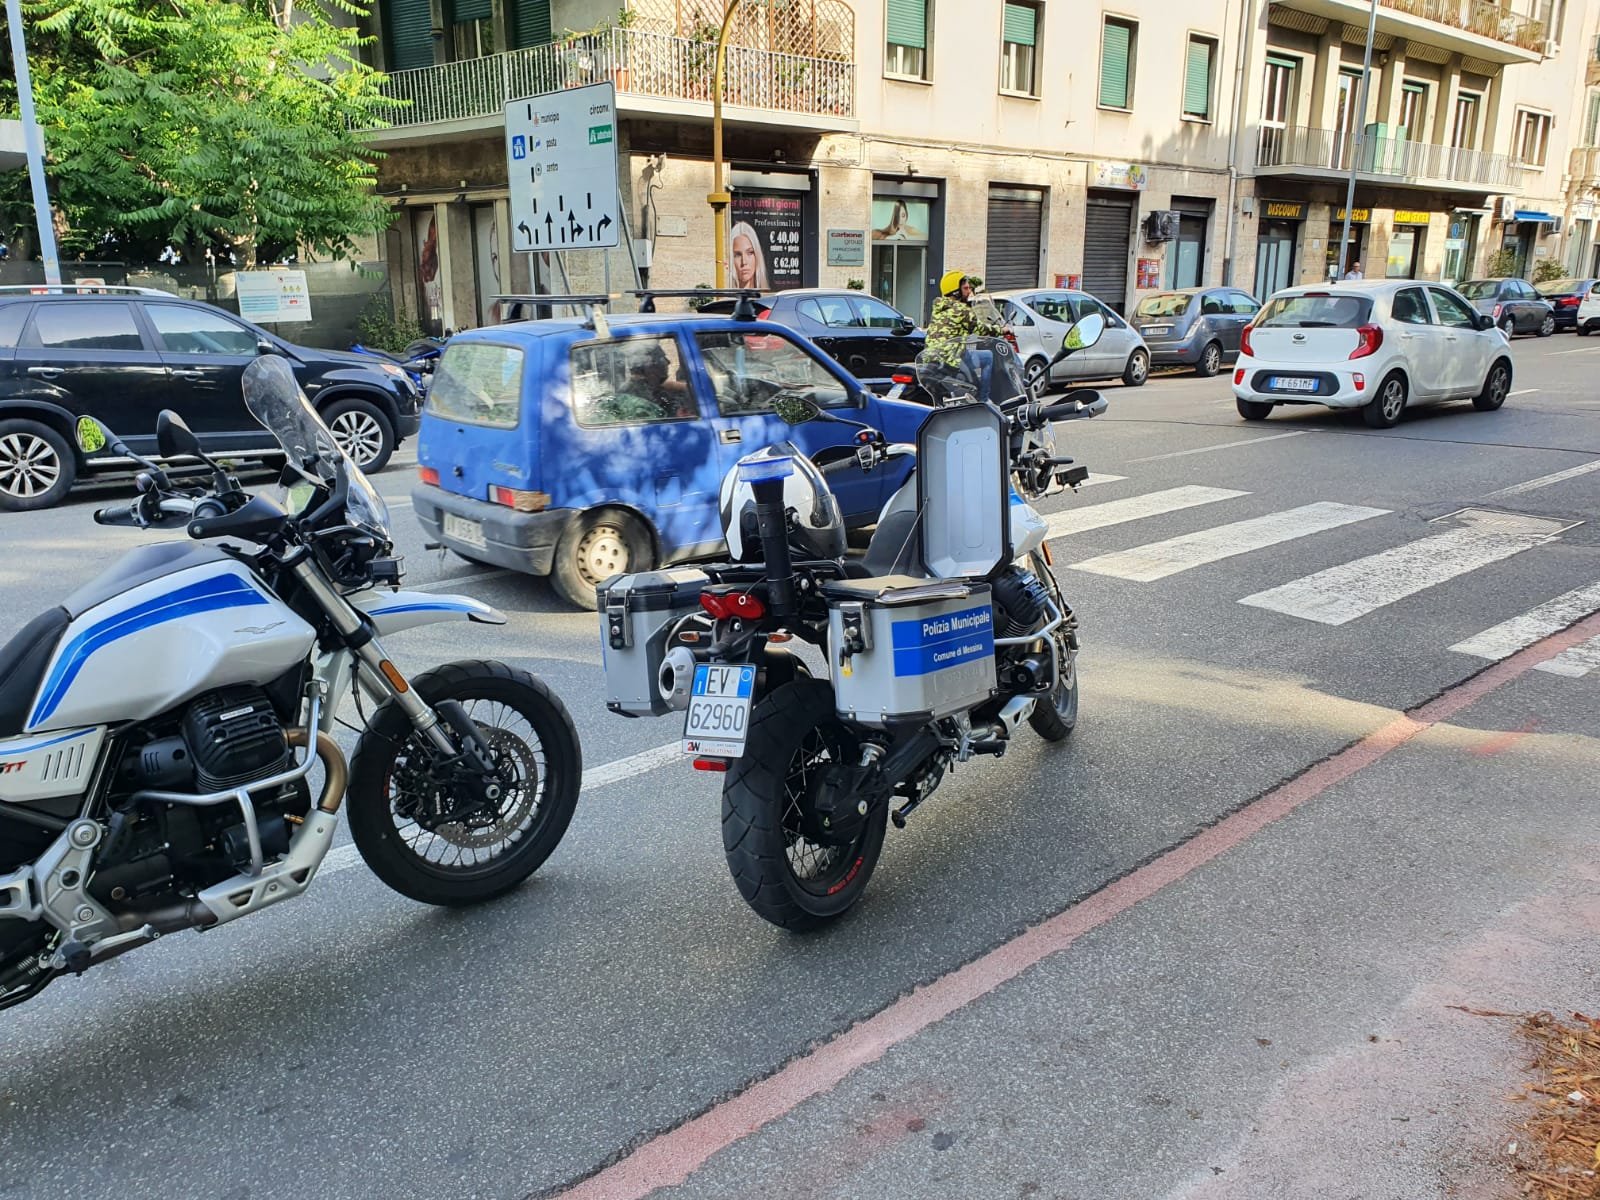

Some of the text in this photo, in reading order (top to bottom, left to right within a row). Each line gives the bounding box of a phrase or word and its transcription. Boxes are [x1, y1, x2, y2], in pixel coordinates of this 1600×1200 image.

[776, 199, 799, 211] giorni
[1267, 203, 1302, 217] DISCOUNT
[777, 231, 799, 245] 40,00
[780, 257, 799, 269] 62,00
[922, 611, 990, 637] Polizia Municipale
[933, 643, 983, 663] Comune di Messina
[706, 668, 730, 695] EV
[690, 702, 745, 732] 62960
